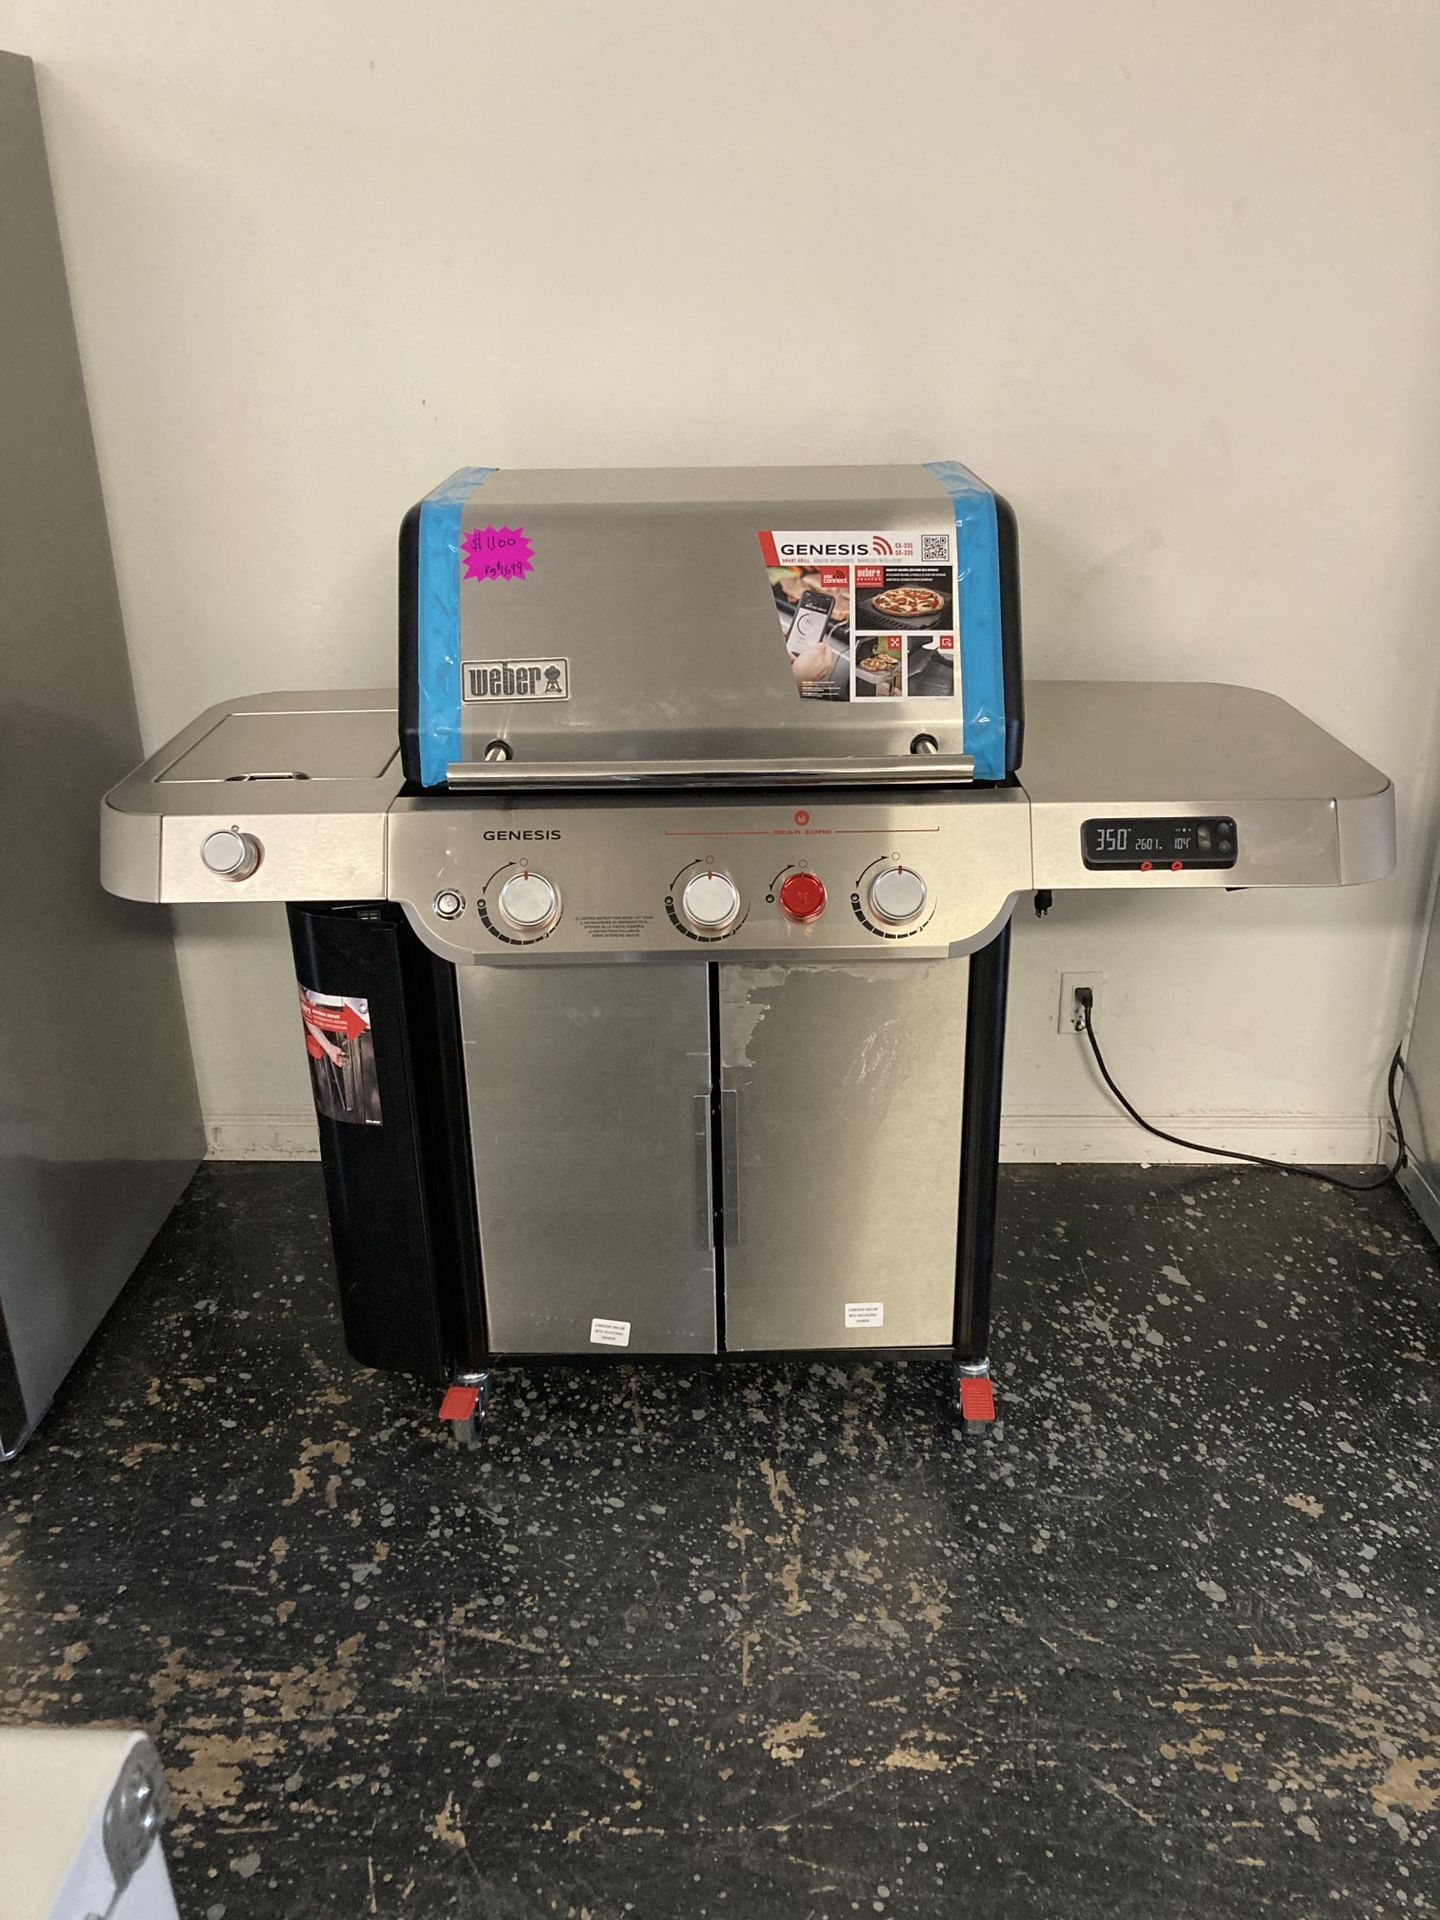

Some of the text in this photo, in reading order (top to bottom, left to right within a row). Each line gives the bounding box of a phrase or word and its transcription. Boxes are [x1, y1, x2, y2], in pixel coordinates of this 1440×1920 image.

[780, 543, 869, 556] GENESIS
[468, 661, 542, 696] weber
[483, 829, 562, 841] GENESIS
